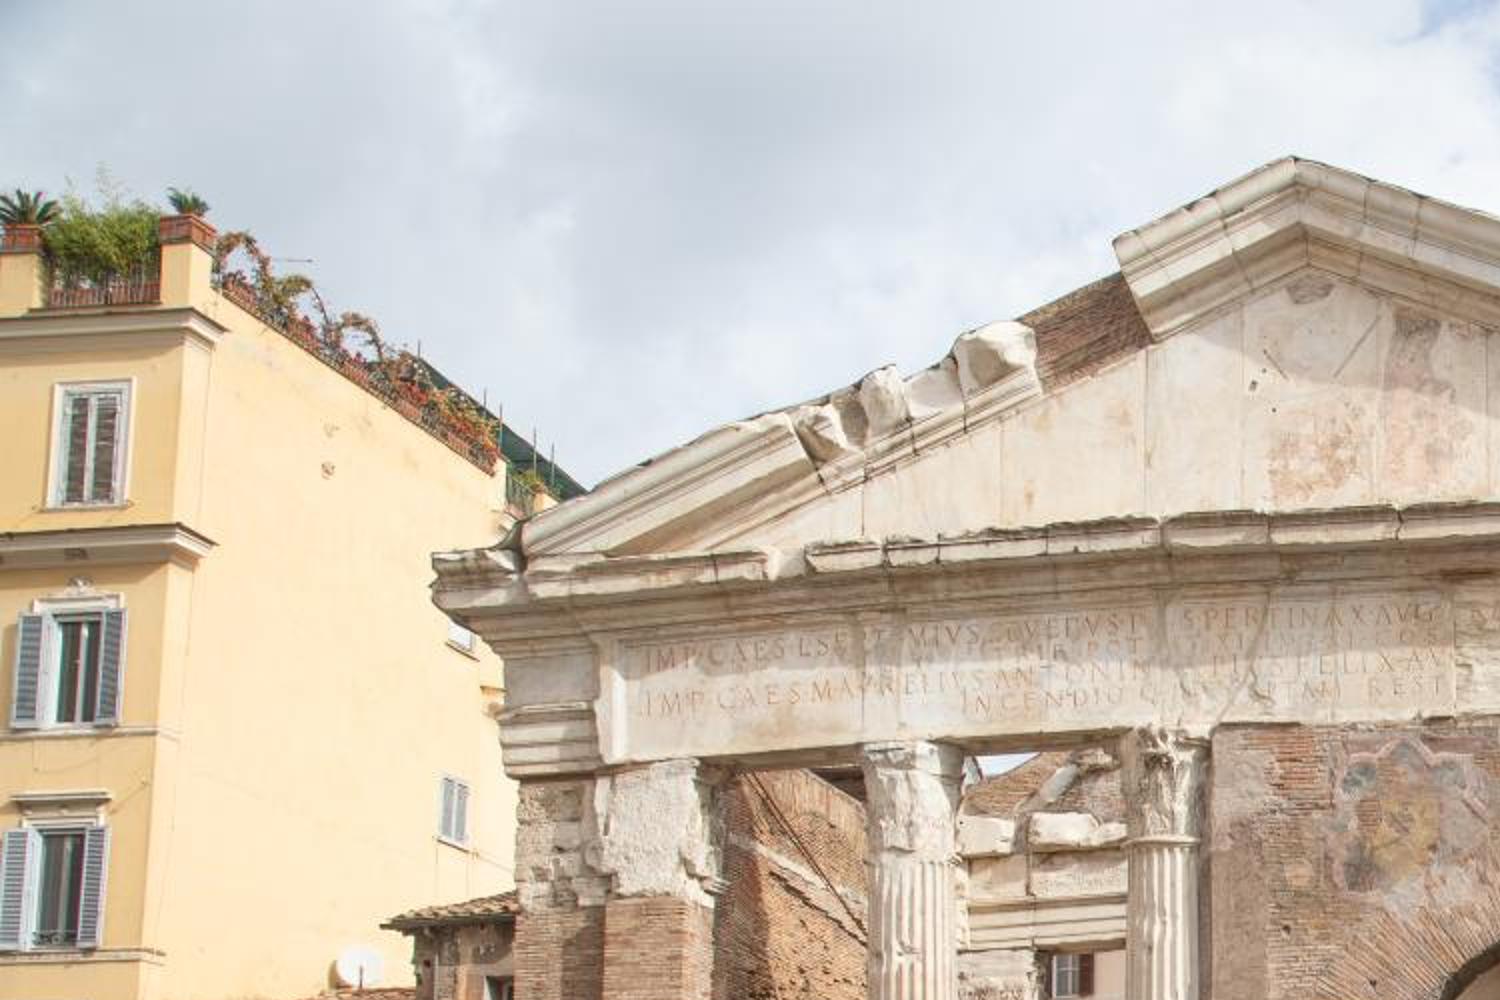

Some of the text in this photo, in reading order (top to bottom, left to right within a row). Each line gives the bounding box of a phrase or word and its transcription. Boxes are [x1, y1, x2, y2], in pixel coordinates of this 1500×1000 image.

[706, 637, 787, 668] CAES
[646, 690, 706, 719] IMP
[717, 682, 802, 710] CAES
